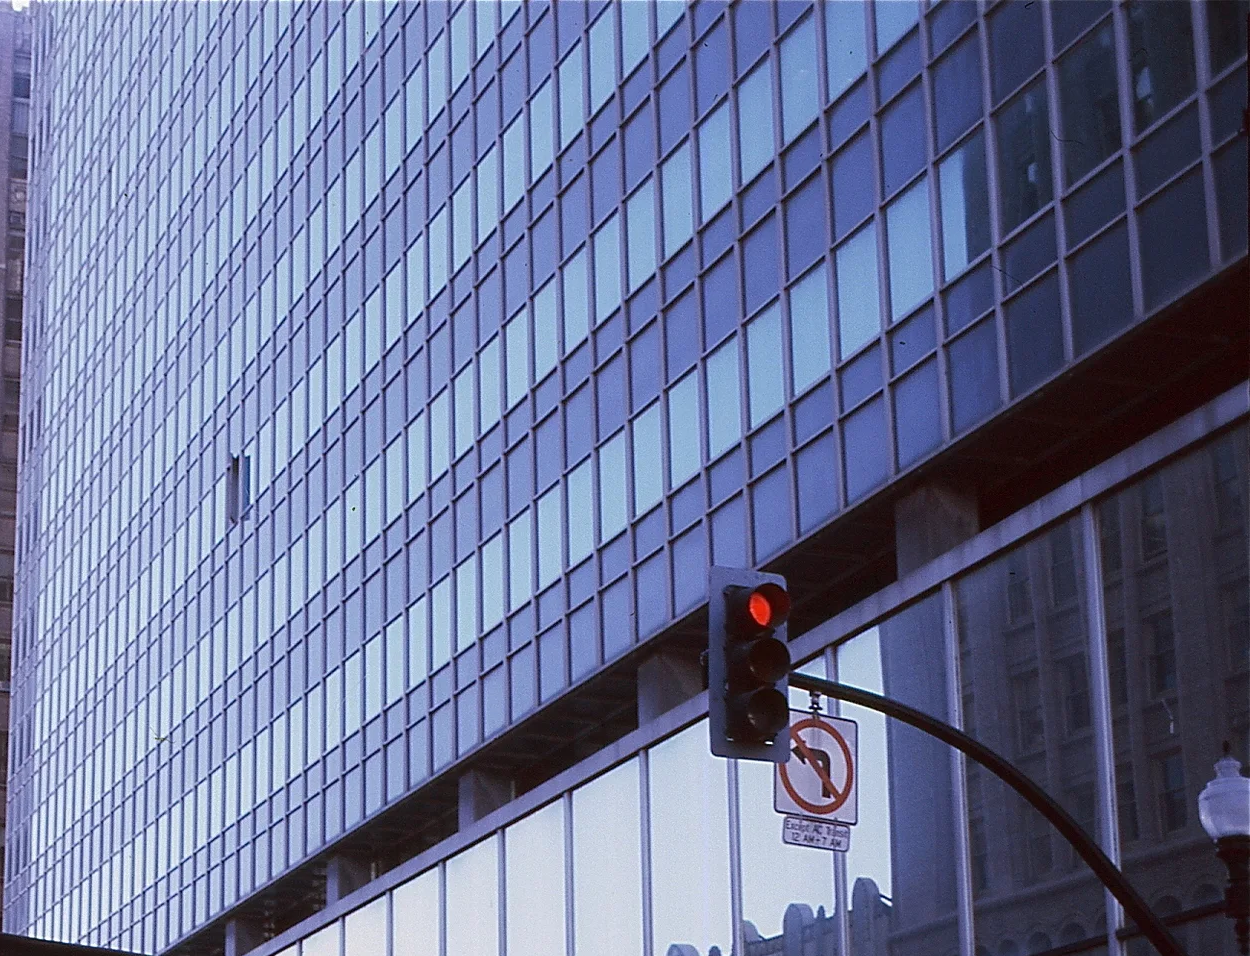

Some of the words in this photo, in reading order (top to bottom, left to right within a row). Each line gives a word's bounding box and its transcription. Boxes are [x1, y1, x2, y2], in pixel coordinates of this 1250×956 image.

[785, 819, 810, 833] Except
[812, 823, 824, 835] AC
[825, 825, 849, 839] Transit
[791, 831, 800, 842] 12
[830, 838, 842, 848] AM
